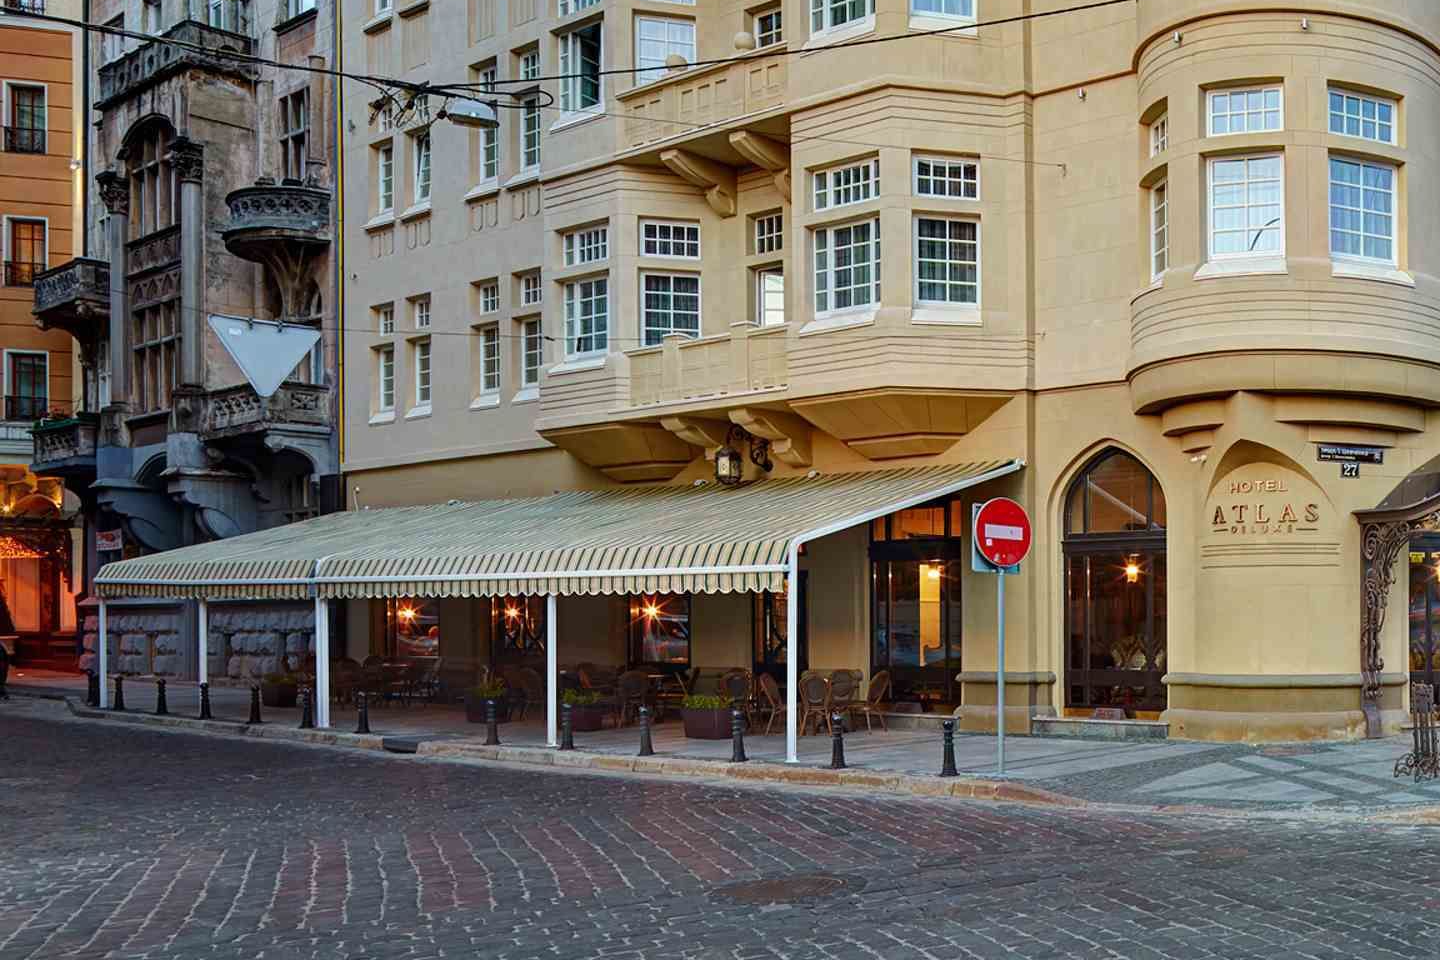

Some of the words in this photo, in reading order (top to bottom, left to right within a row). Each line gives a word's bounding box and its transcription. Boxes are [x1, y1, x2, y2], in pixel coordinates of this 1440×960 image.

[1343, 463, 1358, 477] 27
[1230, 480, 1288, 494] HOTEL
[1211, 503, 1320, 525] ATLAS
